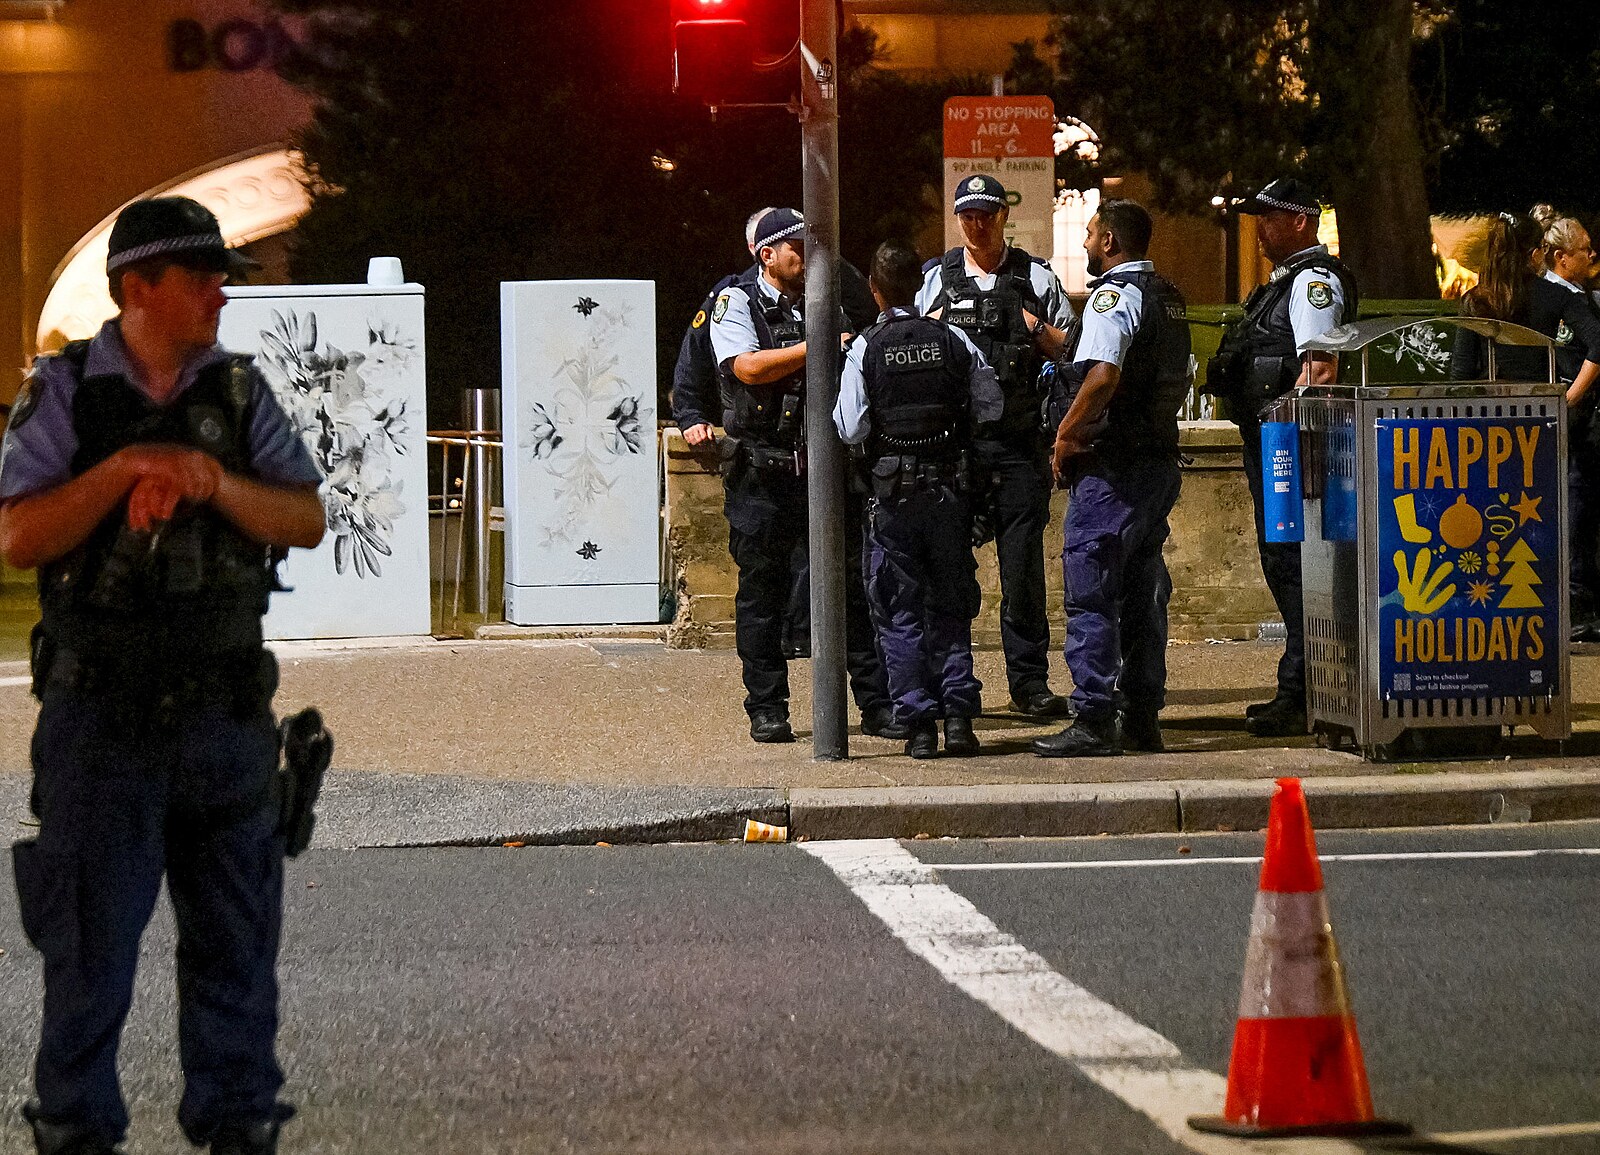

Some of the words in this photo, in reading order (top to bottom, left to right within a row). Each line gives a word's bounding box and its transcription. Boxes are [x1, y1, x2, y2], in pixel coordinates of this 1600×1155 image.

[948, 107, 969, 120] NO
[975, 106, 1048, 120] STOPPING
[977, 122, 1020, 135] AREA
[1006, 161, 1047, 171] PARKING
[948, 316, 976, 324] POLICE
[885, 349, 941, 366] POLICE
[1393, 426, 1540, 489] HAPPY
[1394, 615, 1545, 663] HOLIDAYS
[1415, 673, 1432, 681] Scan
[1441, 672, 1470, 680] checkout
